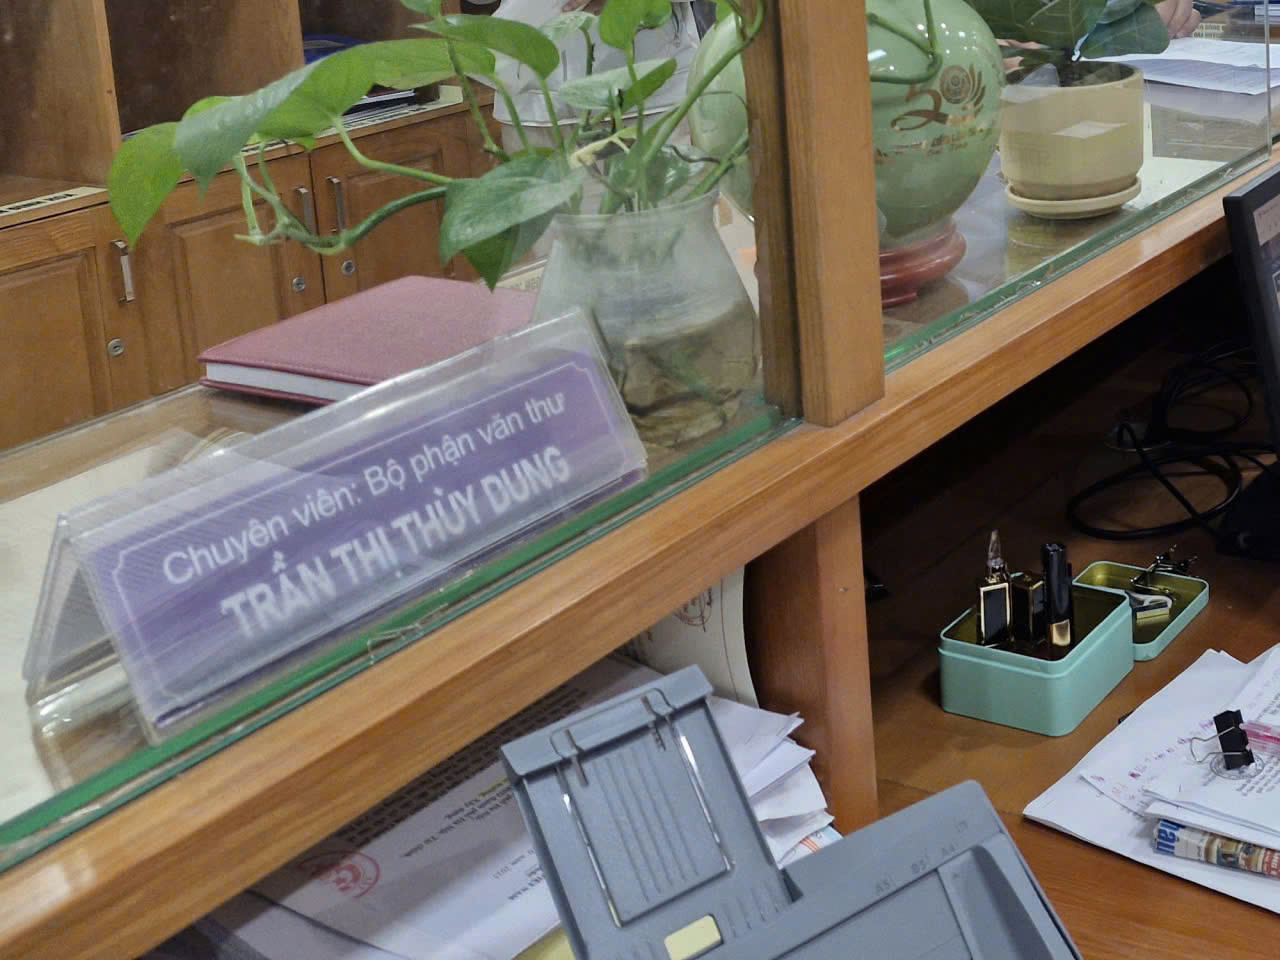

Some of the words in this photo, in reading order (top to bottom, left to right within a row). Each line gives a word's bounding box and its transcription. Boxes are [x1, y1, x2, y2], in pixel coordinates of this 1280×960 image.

[163, 515, 289, 586] Chuyên
[292, 480, 362, 527] viên:
[365, 458, 406, 496] Bộ
[410, 432, 476, 483] phận
[478, 411, 524, 446] văn
[525, 390, 565, 425] thư
[220, 550, 337, 639] TRẦN
[330, 526, 403, 580] THỊ
[391, 486, 480, 554] THÙY
[480, 445, 571, 515] DUNG
